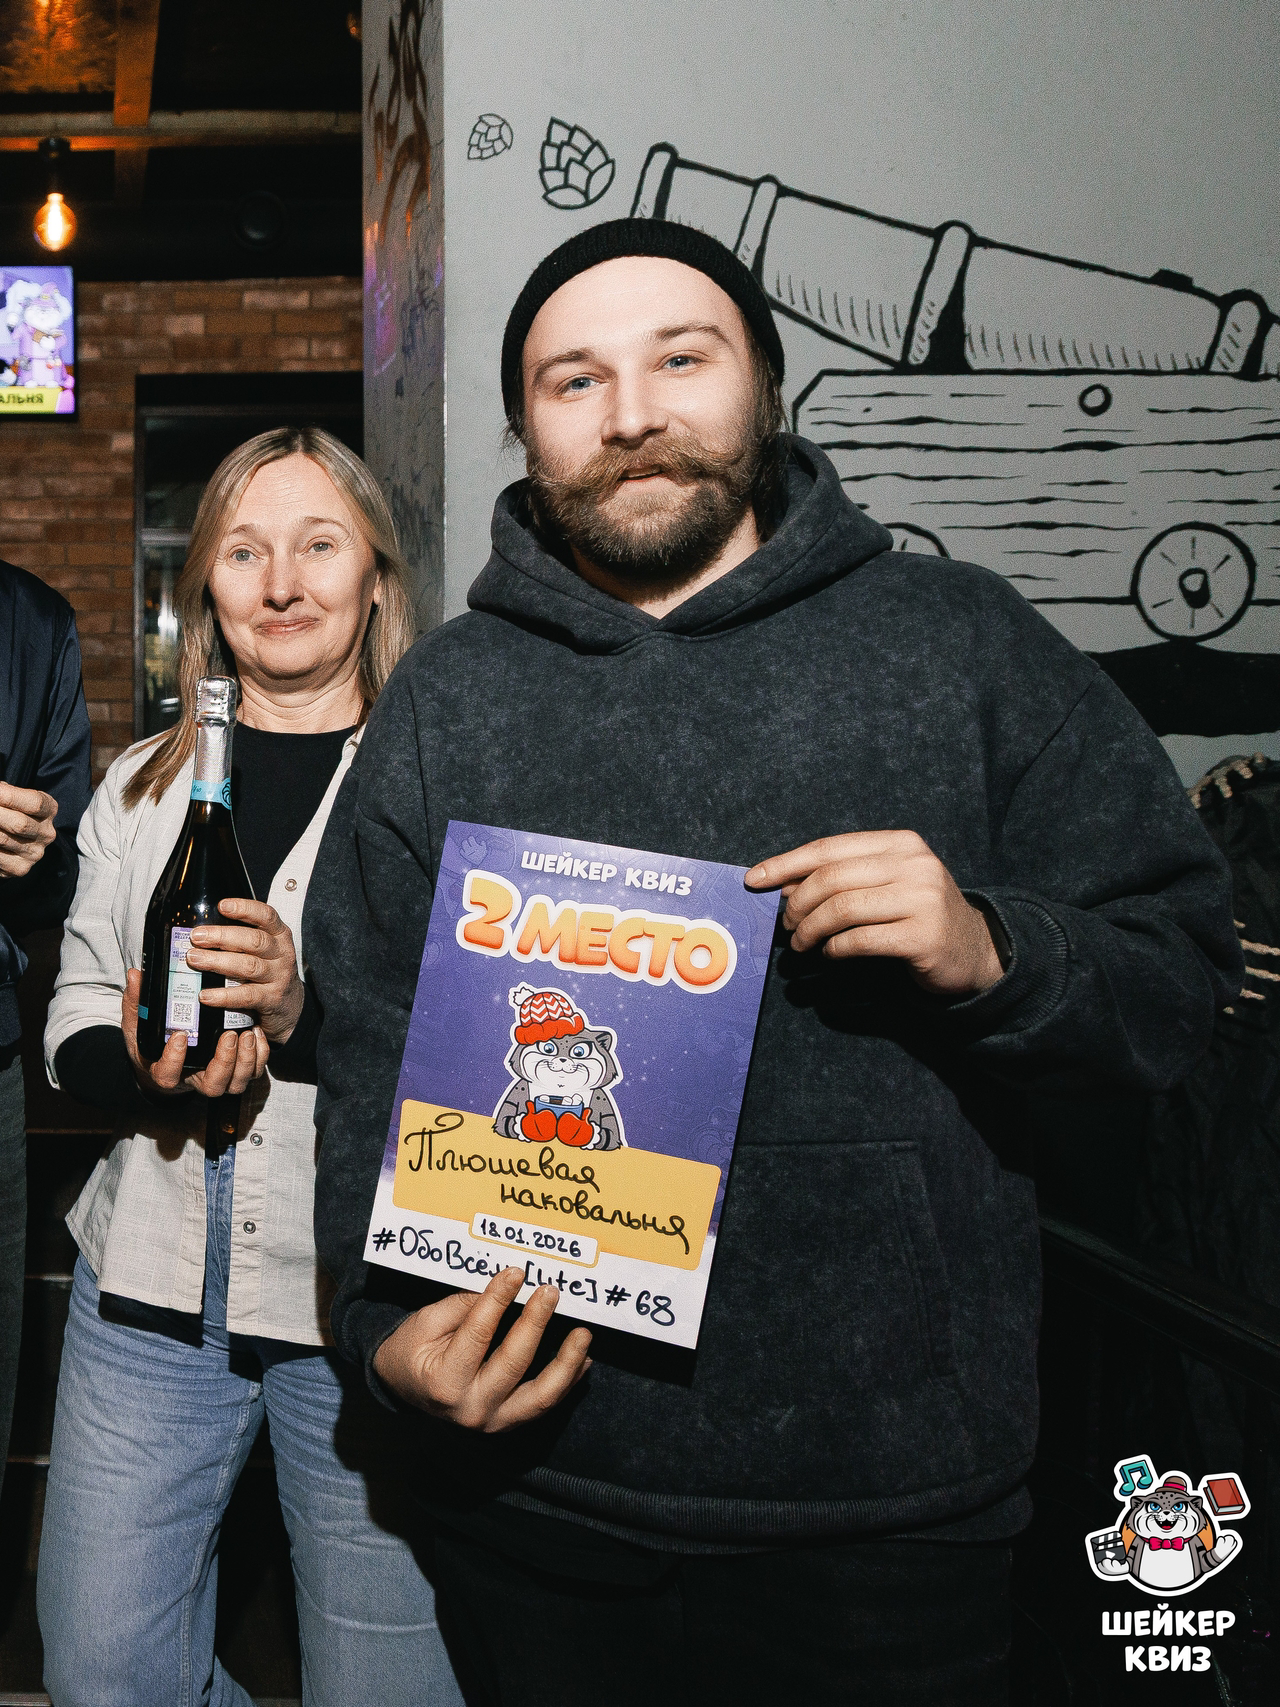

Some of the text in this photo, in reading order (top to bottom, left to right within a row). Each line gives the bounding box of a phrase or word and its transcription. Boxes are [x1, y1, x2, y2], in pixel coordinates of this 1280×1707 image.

[521, 850, 694, 896] ШЕЙКЕР КВИЗ
[463, 877, 729, 986] 2 МЕСТО
[404, 1112, 601, 1193] Плюшевая
[480, 1218, 582, 1258] 18.01.2026
[500, 1184, 690, 1255] наковальня
